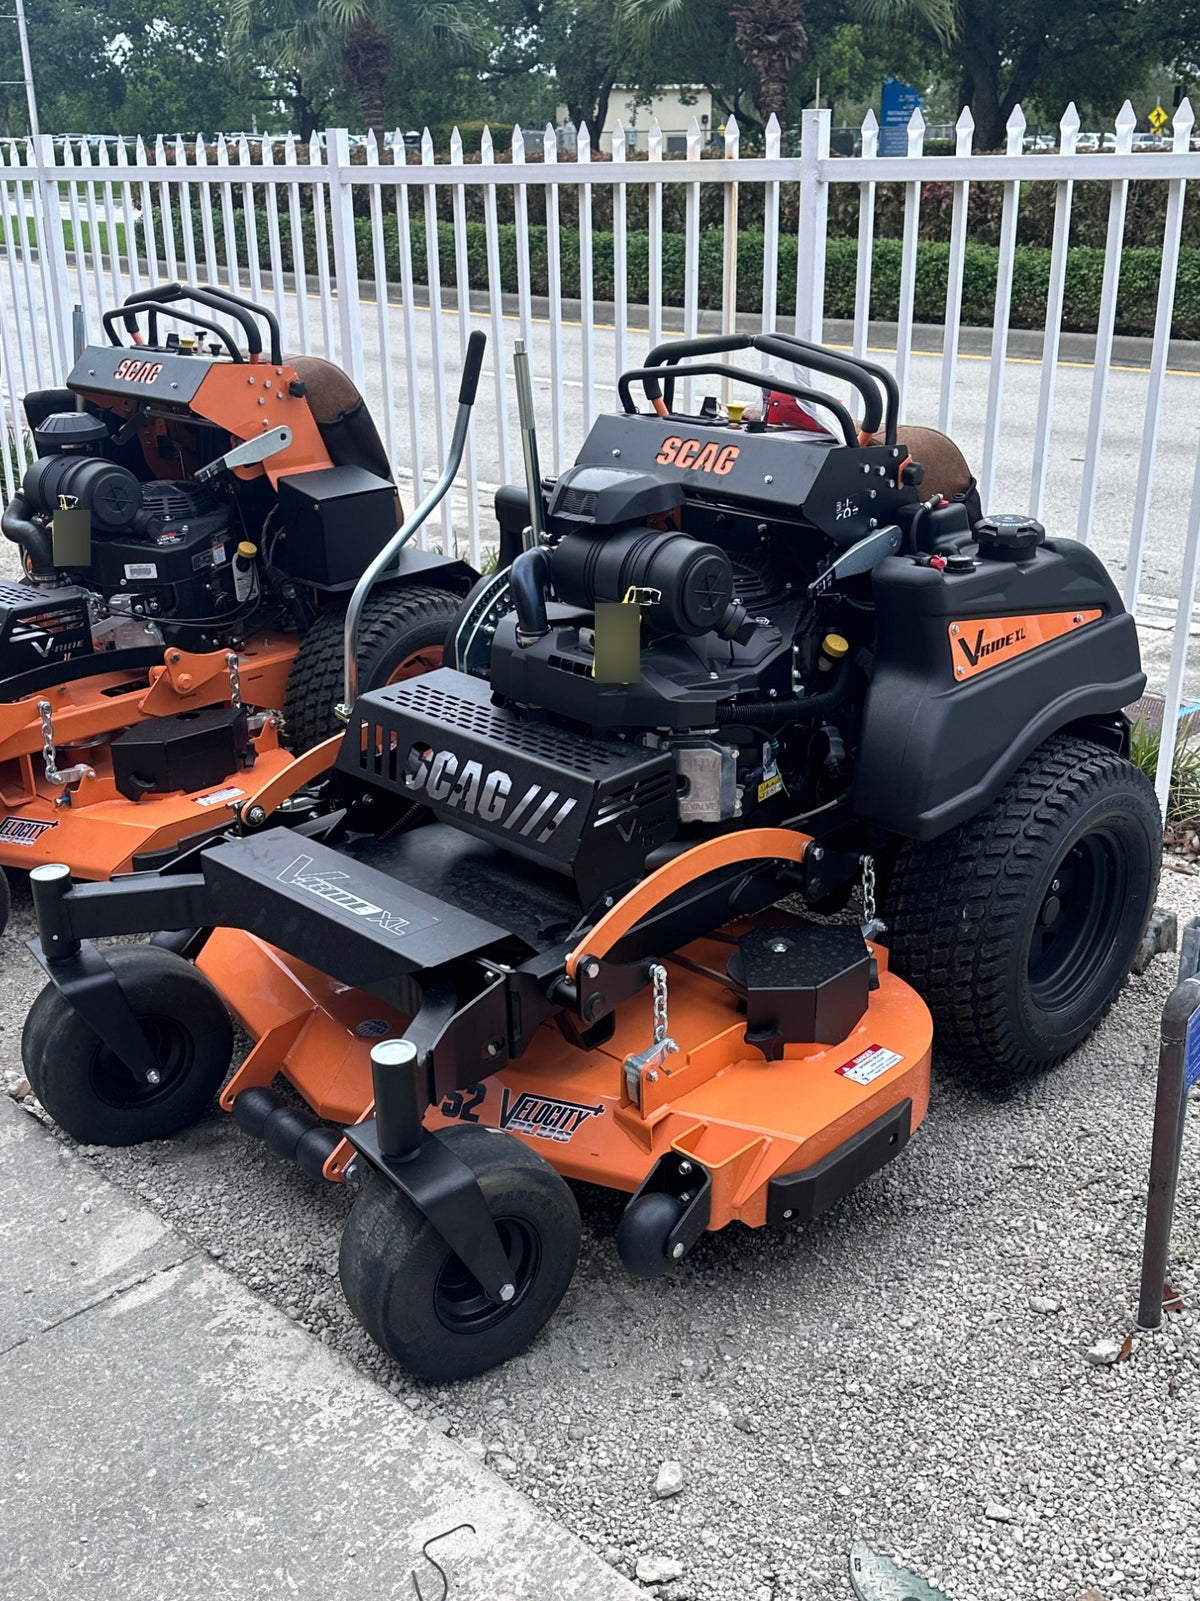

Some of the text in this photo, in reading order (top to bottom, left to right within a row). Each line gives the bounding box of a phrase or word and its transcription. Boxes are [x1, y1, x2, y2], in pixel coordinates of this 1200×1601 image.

[113, 358, 163, 384] SCAG
[655, 435, 740, 475] SCAG
[1015, 627, 1027, 643] XL
[401, 741, 513, 822] SCAG
[0, 816, 60, 840] ELOCITY
[365, 910, 411, 936] XL
[506, 1119, 573, 1144] PLUS
